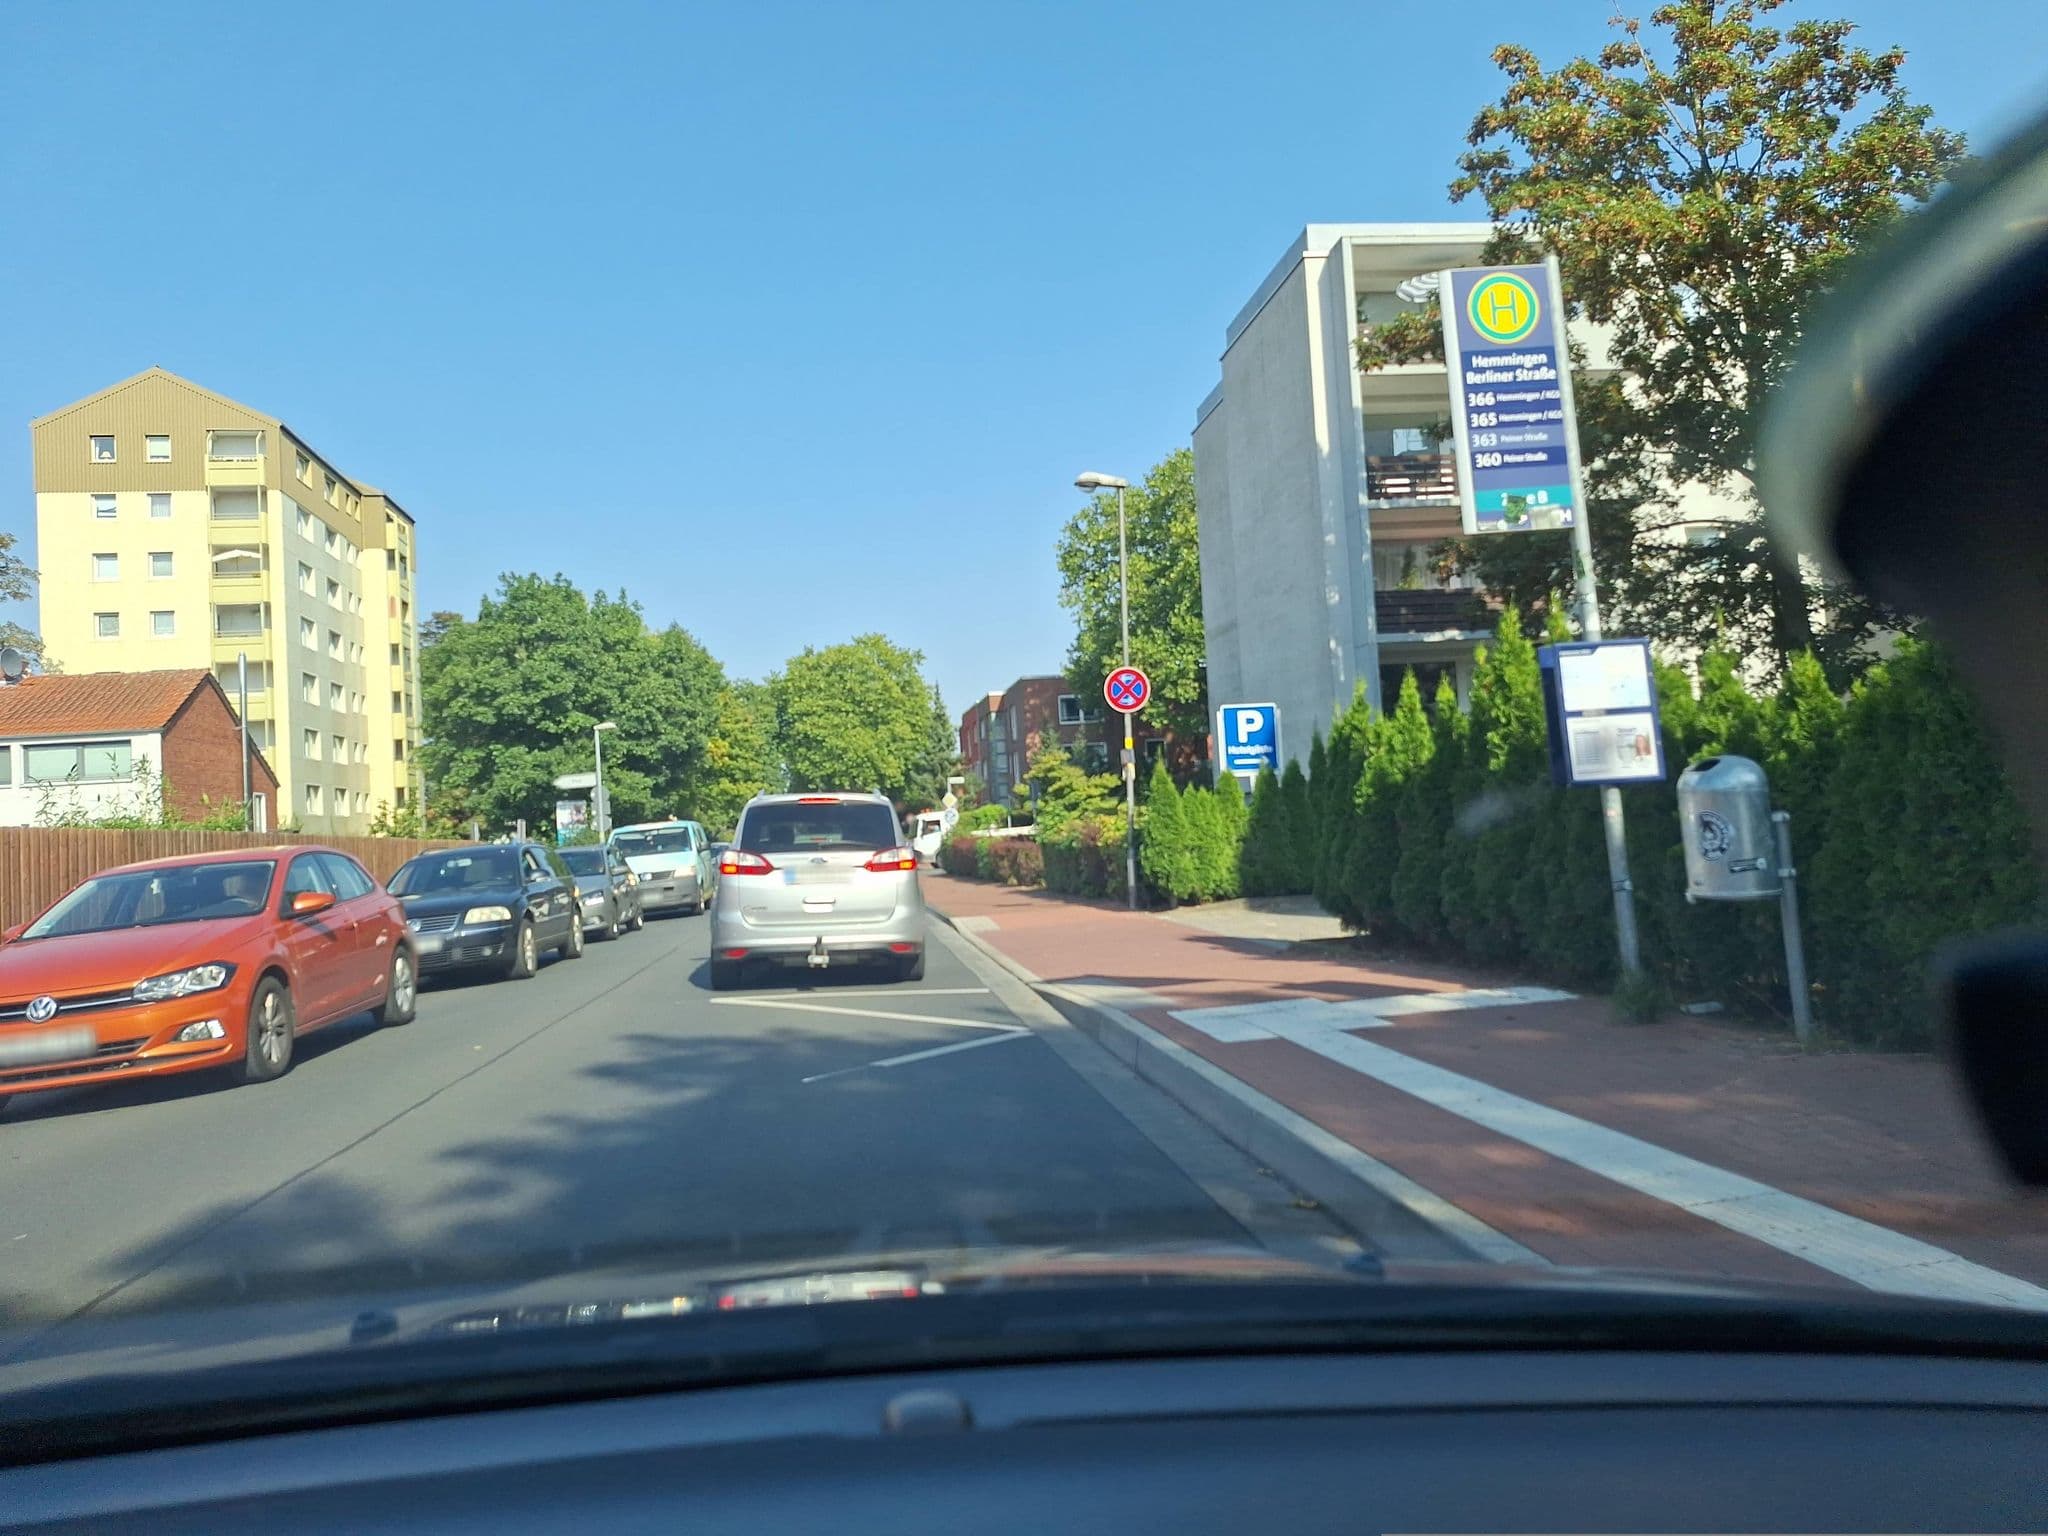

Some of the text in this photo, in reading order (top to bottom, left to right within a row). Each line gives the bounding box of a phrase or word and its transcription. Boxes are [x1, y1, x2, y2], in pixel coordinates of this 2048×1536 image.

[1489, 289, 1518, 325] H
[1472, 352, 1548, 369] Hemmingen
[1466, 366, 1556, 385] Berliner Straße
[1468, 391, 1496, 407] 366
[1496, 391, 1541, 402] Hemmingen
[1470, 411, 1498, 428] 365
[1498, 412, 1543, 423] Hemmingen
[1472, 433, 1498, 448] 363
[1523, 431, 1549, 442] Straße
[1474, 452, 1503, 468] 360
[1524, 451, 1549, 462] Straße
[1236, 709, 1264, 744] P
